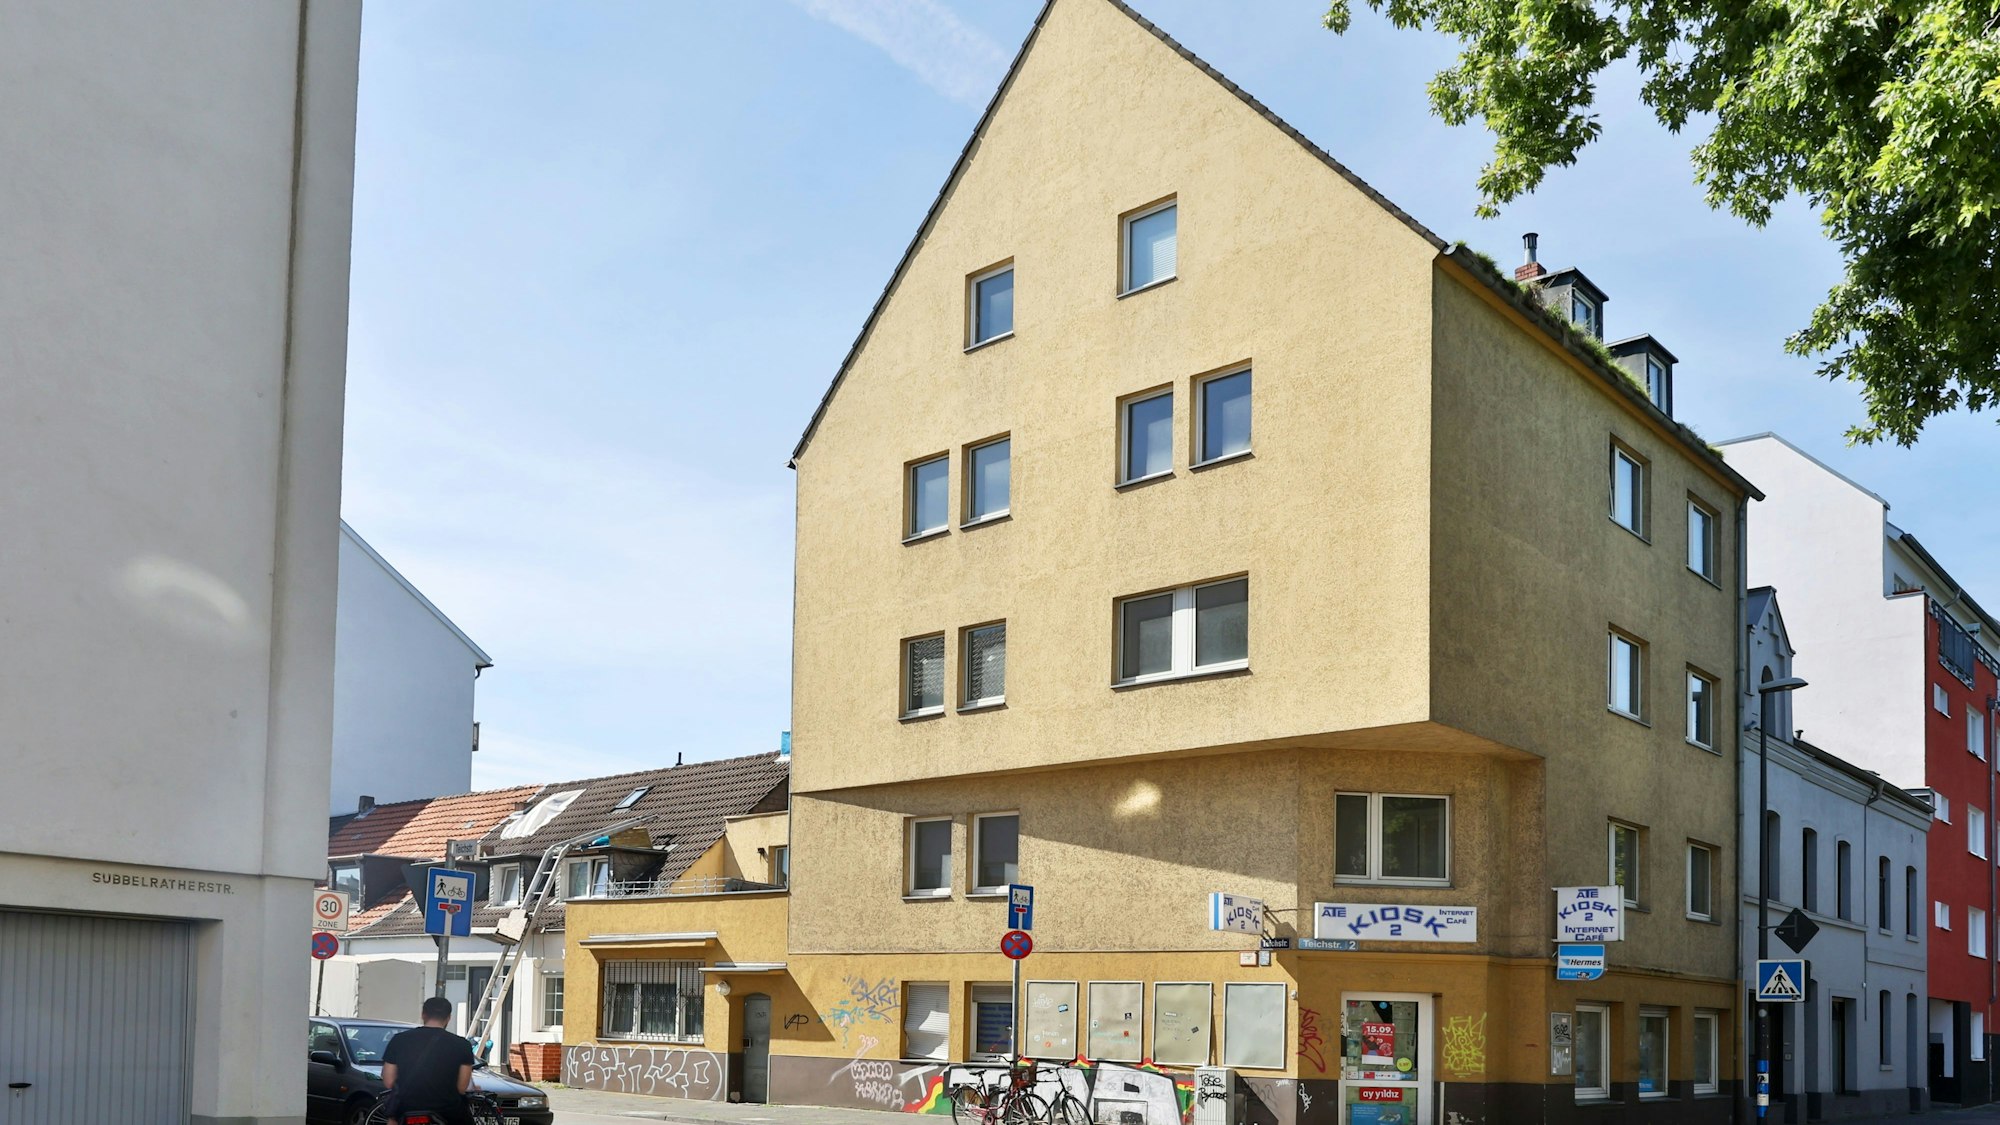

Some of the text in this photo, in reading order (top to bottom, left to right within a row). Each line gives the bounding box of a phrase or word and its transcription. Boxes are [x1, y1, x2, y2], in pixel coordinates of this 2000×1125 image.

[92, 872, 235, 895] SUBBELRATHERSTR.
[1576, 888, 1599, 899] ATE
[321, 900, 337, 913] 30
[1322, 906, 1347, 918] ATE
[1558, 901, 1618, 920] KIOSK
[1226, 906, 1260, 929] KIOSK
[1348, 906, 1447, 938] KIOSK
[1446, 917, 1467, 925] CAFÉ
[1584, 912, 1593, 922] 2
[317, 919, 339, 929] ZONE
[1240, 920, 1246, 930] 2
[1564, 925, 1615, 934] INTERNET
[1390, 924, 1402, 936] 2
[1575, 933, 1604, 942] CAFÉ
[1303, 939, 1356, 950] Teichstr. 2
[1570, 958, 1602, 966] Hermes
[1366, 1025, 1393, 1034] 15.09.
